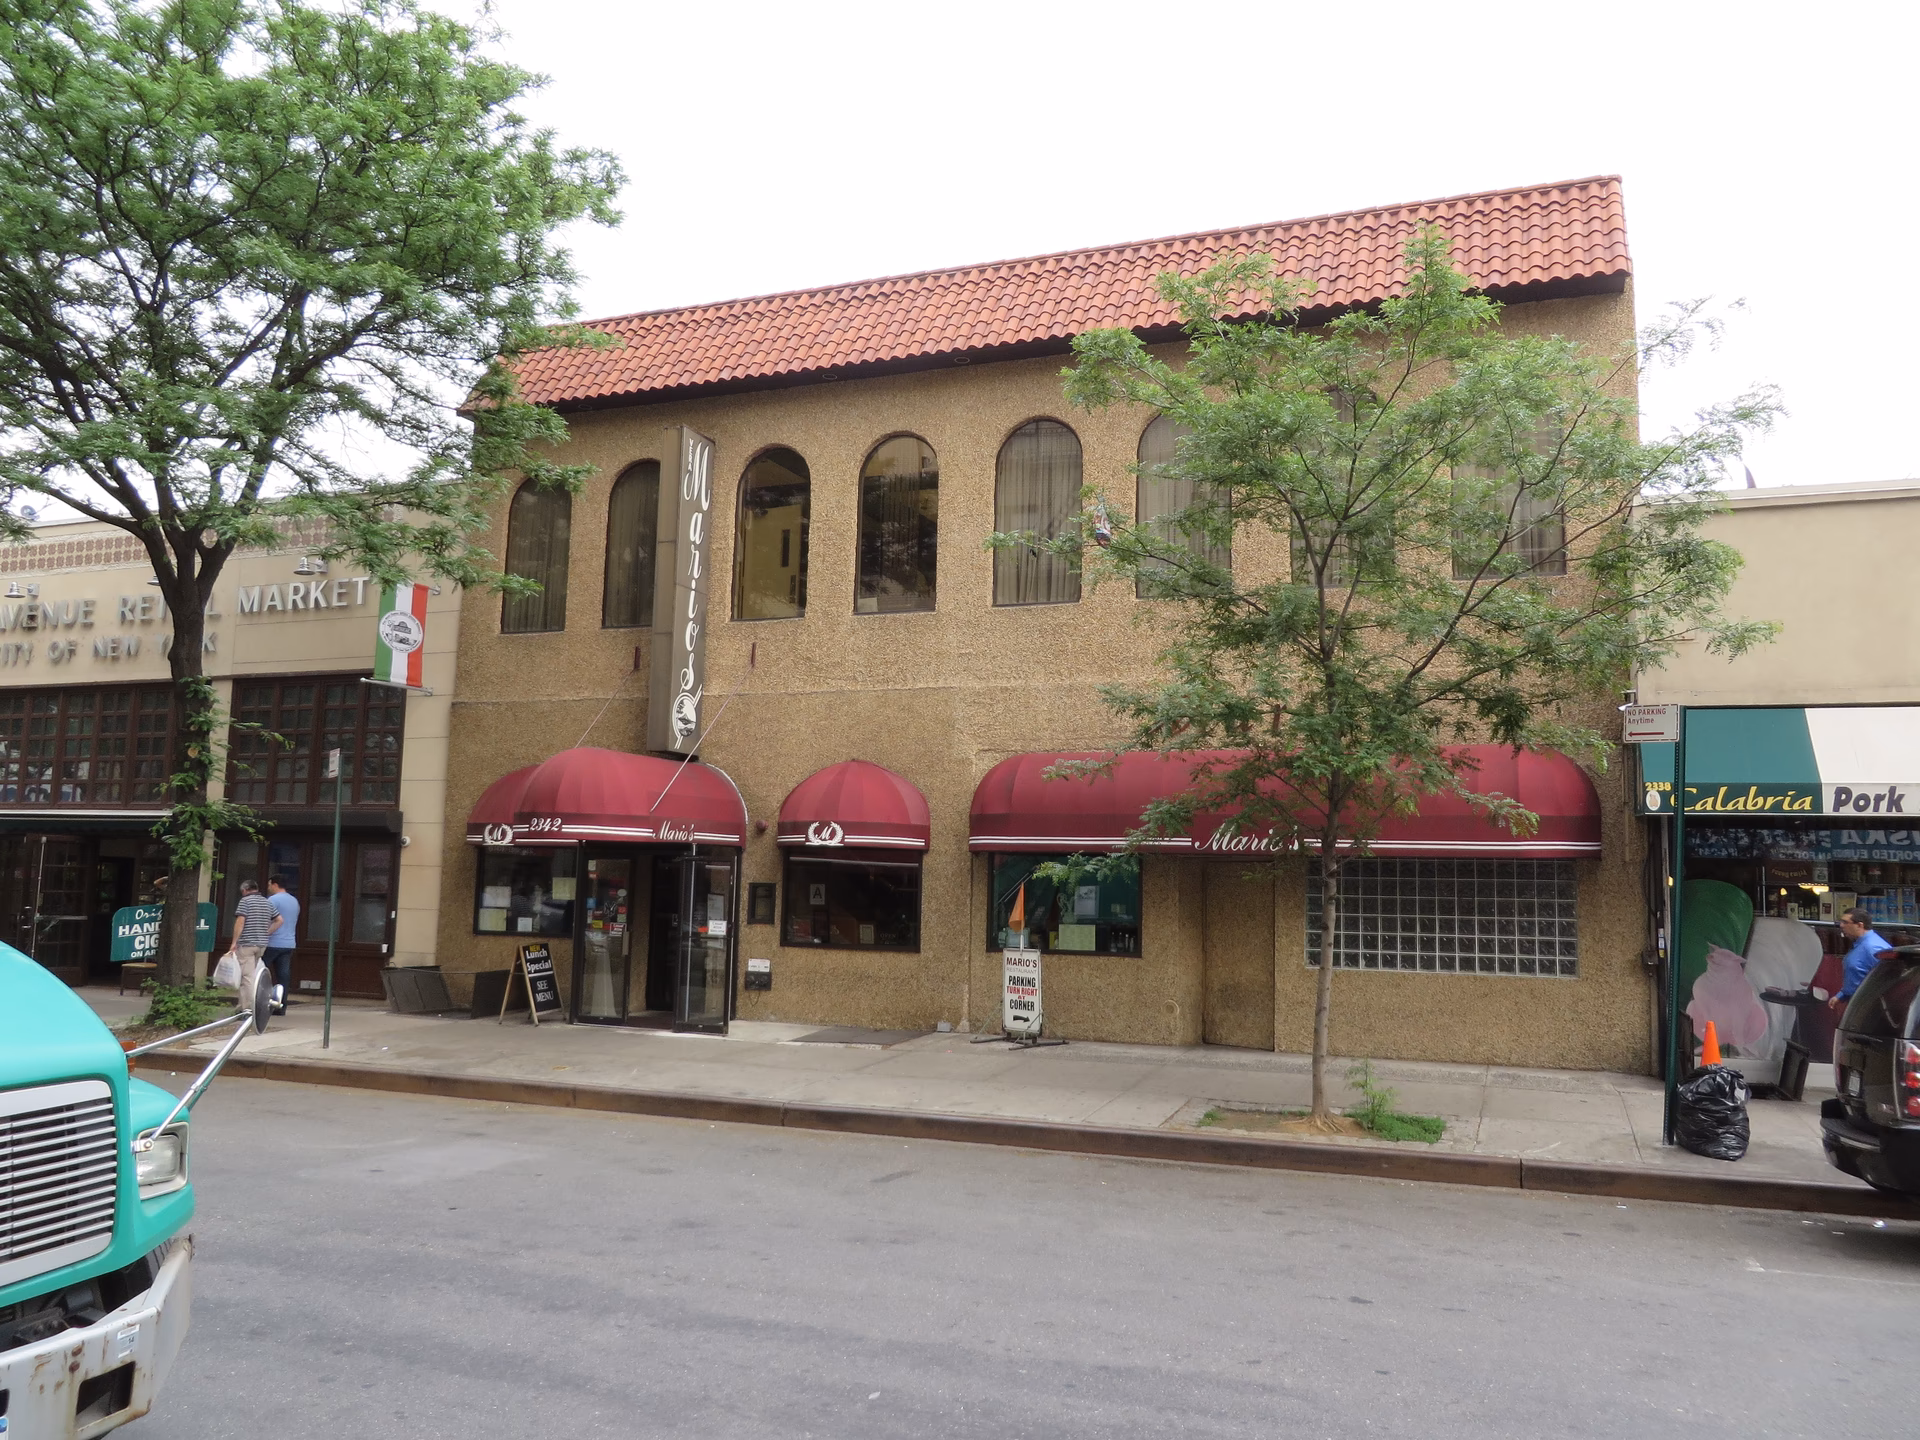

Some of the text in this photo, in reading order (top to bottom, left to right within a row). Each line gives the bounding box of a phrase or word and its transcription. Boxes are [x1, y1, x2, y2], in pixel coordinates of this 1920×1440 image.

[0, 576, 370, 629] VENUE RETL MARKET
[0, 631, 217, 668] ITY OF NEW YK
[1638, 707, 1667, 715] PARKING
[1627, 717, 1654, 725] Anytime
[1645, 782, 1672, 791] 2338
[1669, 785, 1906, 813] Calabria Pork
[530, 817, 562, 832] 2342
[652, 820, 694, 841] Mario's
[134, 935, 160, 950] CIG
[526, 948, 548, 959] Lunch
[527, 959, 552, 973] Special
[1006, 957, 1037, 968] MARIO'S
[536, 980, 548, 990] SEE
[1008, 976, 1036, 987] PARKING
[535, 991, 554, 1002] MENU
[1006, 986, 1038, 996] TURN RIGHT
[1009, 999, 1035, 1011] CORNER
